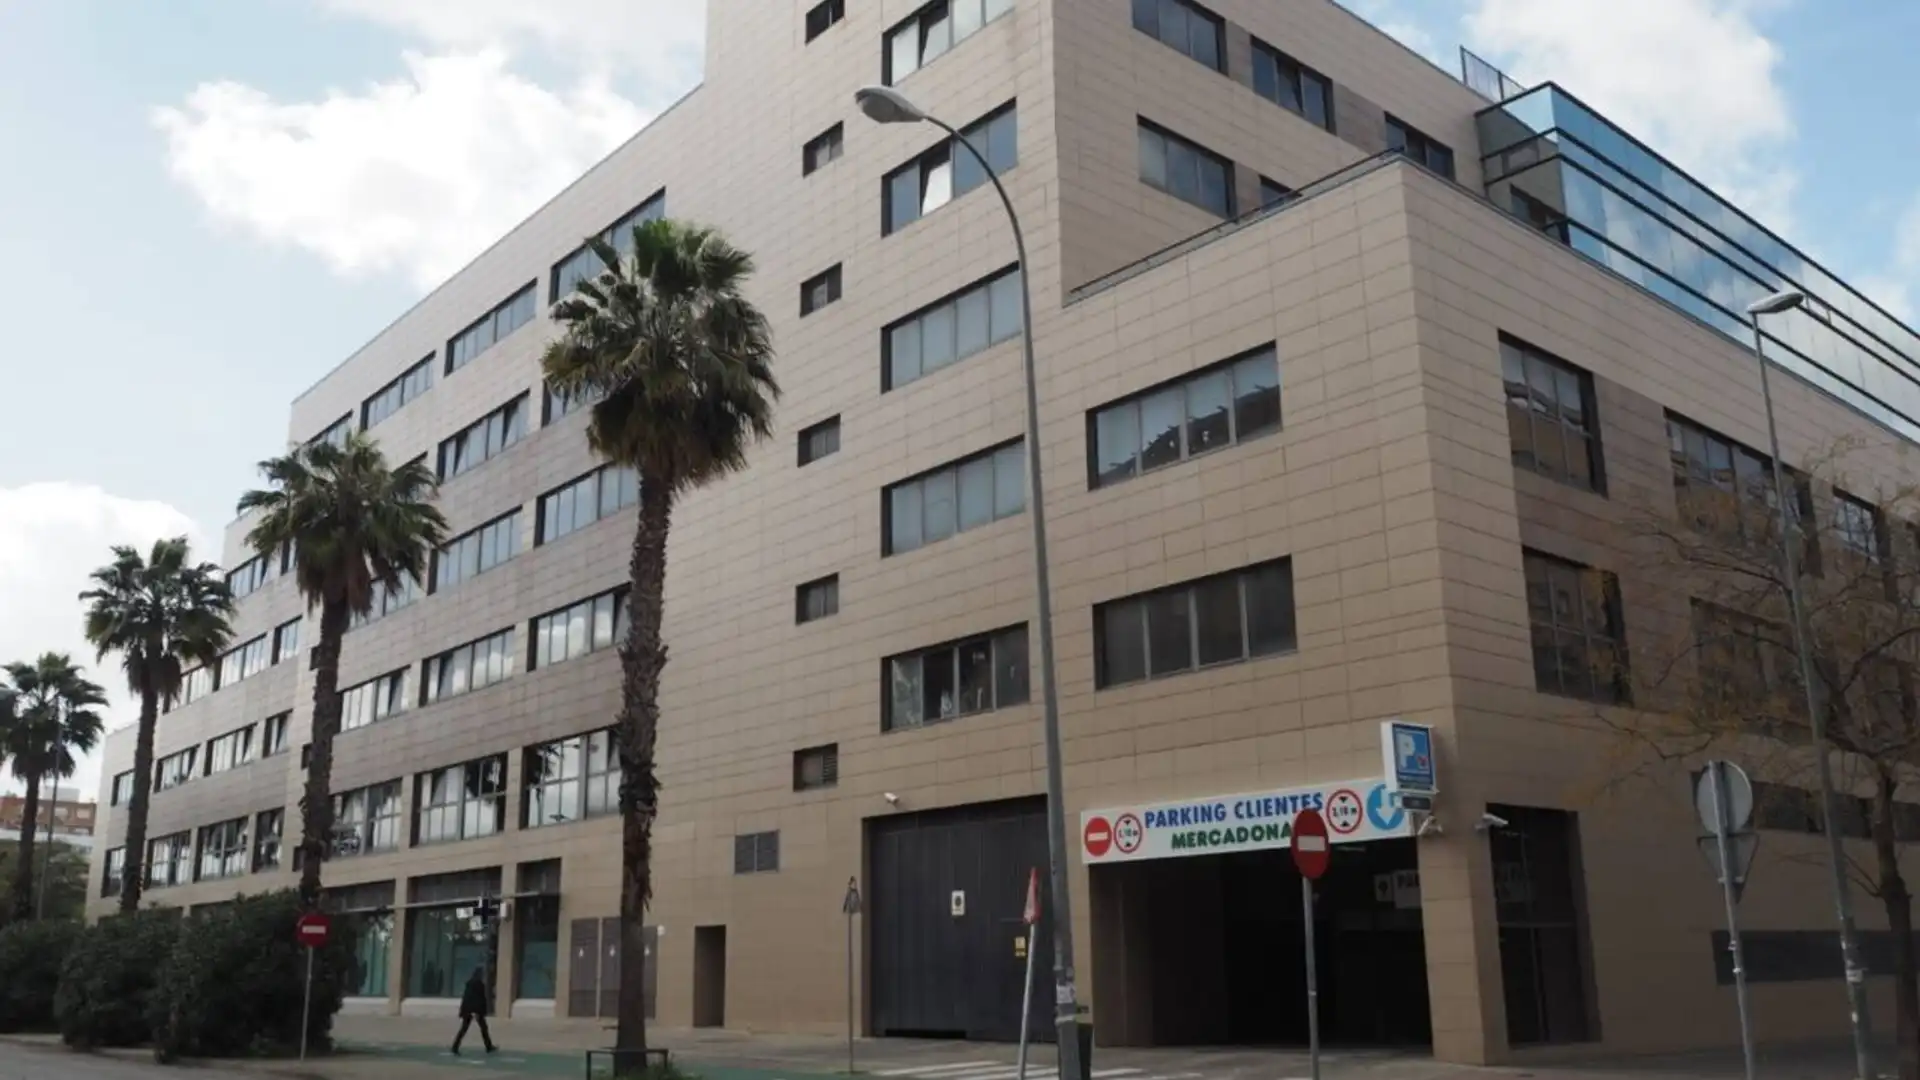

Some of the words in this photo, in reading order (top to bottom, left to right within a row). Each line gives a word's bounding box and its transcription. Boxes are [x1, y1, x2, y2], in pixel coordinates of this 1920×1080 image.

[1144, 803, 1226, 829] PARKING
[1234, 792, 1323, 819] CLIENTES
[1171, 821, 1292, 850] MERCADONA
